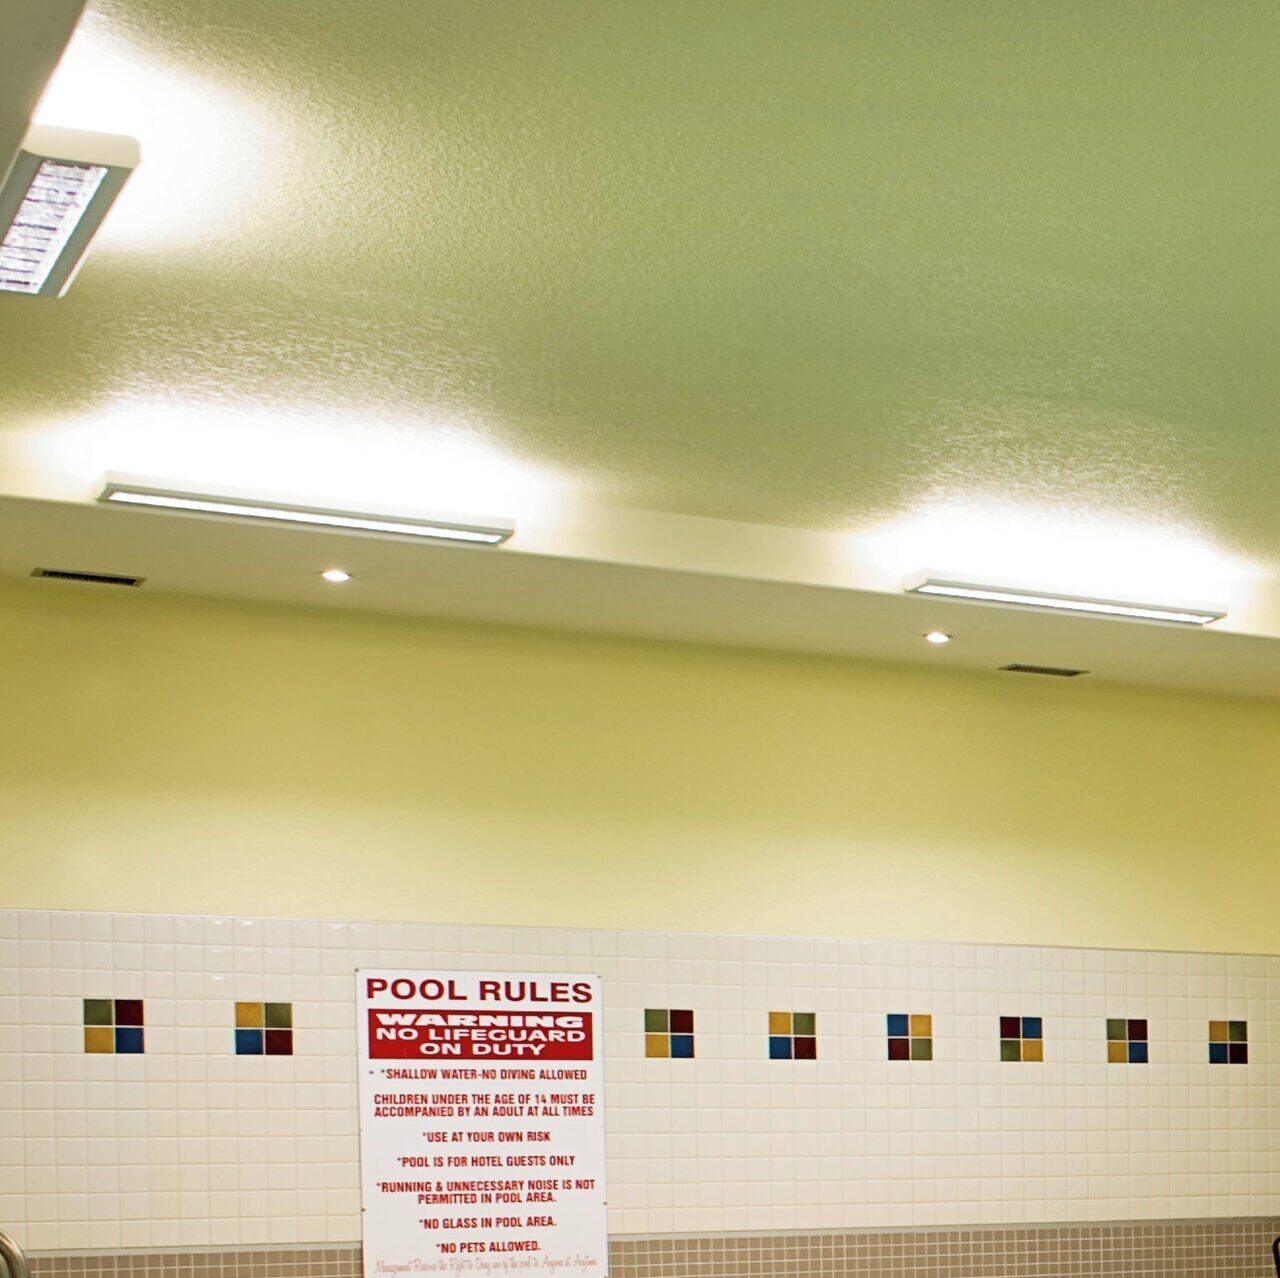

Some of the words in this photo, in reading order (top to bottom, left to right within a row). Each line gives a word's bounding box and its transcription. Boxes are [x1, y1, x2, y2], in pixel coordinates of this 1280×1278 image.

[366, 978, 467, 1000] POOL
[479, 981, 592, 1002] RULES
[376, 1014, 583, 1028] WARNING
[376, 1028, 418, 1039] NO
[429, 1029, 585, 1041] LIFEGUARD
[419, 1043, 461, 1054] ON
[472, 1043, 545, 1054] DUTY
[440, 1069, 496, 1079] WATER-NO
[500, 1069, 535, 1079] DIVING
[539, 1069, 587, 1079] ALLOWED
[374, 1094, 428, 1104] CHILDREN
[432, 1094, 468, 1104] UNDER
[471, 1093, 490, 1104] THE
[494, 1094, 514, 1104] AGE
[518, 1093, 530, 1104] OF
[535, 1094, 546, 1103] 14
[550, 1094, 578, 1104] MUST
[582, 1094, 594, 1104] BE
[374, 1106, 454, 1116] ACCOMPANIED
[457, 1106, 470, 1116] BY
[474, 1106, 488, 1116] AN
[492, 1106, 524, 1116] ADULT
[527, 1106, 538, 1116] AT
[541, 1106, 560, 1116] ALL
[562, 1106, 593, 1116] TIMES
[451, 1131, 463, 1141] AT
[466, 1131, 494, 1141] YOUR
[498, 1131, 522, 1141] OWN
[527, 1131, 550, 1141] RISK
[433, 1156, 444, 1167] IS
[447, 1156, 467, 1166] FOR
[471, 1156, 503, 1166] HOTEL
[506, 1155, 546, 1166] GUESTS
[549, 1155, 575, 1165] ONLY
[435, 1181, 443, 1191] &
[446, 1180, 524, 1191] UNNECESSARY
[527, 1179, 558, 1190] NOISE
[562, 1179, 572, 1189] IS
[575, 1179, 595, 1189] NOT
[418, 1193, 477, 1204] PERMITTED
[480, 1193, 492, 1203] IN
[495, 1192, 522, 1202] POOL
[526, 1192, 557, 1202] AREA.
[442, 1218, 477, 1228] GLASS
[481, 1217, 492, 1227] IN
[495, 1217, 522, 1227] POOL
[526, 1216, 557, 1226] AREA.
[459, 1242, 485, 1252] PETS
[489, 1240, 541, 1251] ALLOWED.
